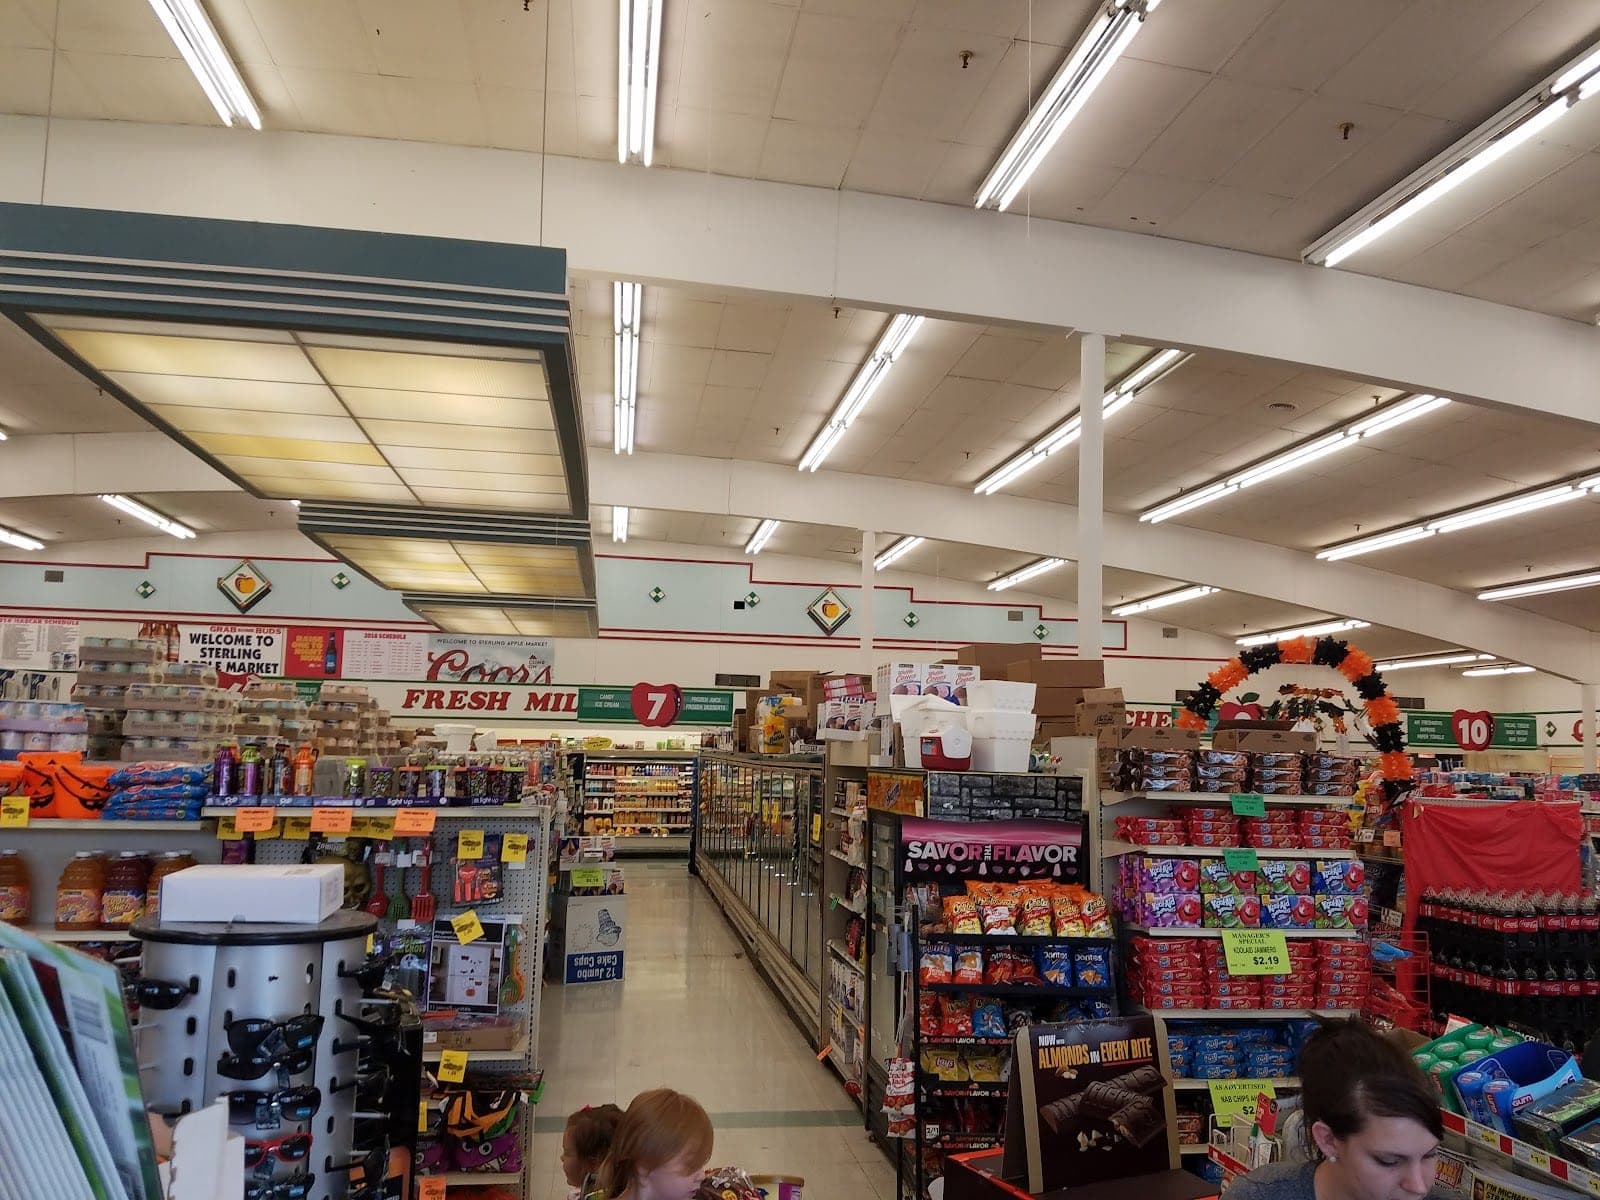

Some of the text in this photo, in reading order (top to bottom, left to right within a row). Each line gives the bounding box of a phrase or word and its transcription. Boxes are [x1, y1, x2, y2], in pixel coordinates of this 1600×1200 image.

[209, 625, 237, 633] GRAB
[255, 627, 282, 635] BUDS
[189, 633, 274, 647] WELCOME TO
[199, 647, 262, 660] STERLING
[226, 661, 279, 674] MARKET
[426, 649, 551, 685] Coors
[402, 689, 578, 712] FRESH MIL
[646, 692, 667, 720] 7
[1125, 710, 1172, 728] CHE
[1458, 718, 1488, 745] 10
[908, 839, 1077, 863] SAVOR THE FLAVOR
[1233, 946, 1277, 954] KOOLAID JAMMERS
[574, 954, 617, 968] Cake Cups
[1075, 953, 1103, 961] Doritos
[1253, 956, 1280, 965] $2.19
[577, 967, 617, 980] 12 Jumbo
[1038, 1035, 1056, 1047] NOW
[1039, 1037, 1153, 1069] ALMONDS IN EVERY BITE
[1220, 1095, 1233, 1103] NAB
[1234, 1095, 1250, 1103] CHIPS
[1242, 1105, 1255, 1115] $2
